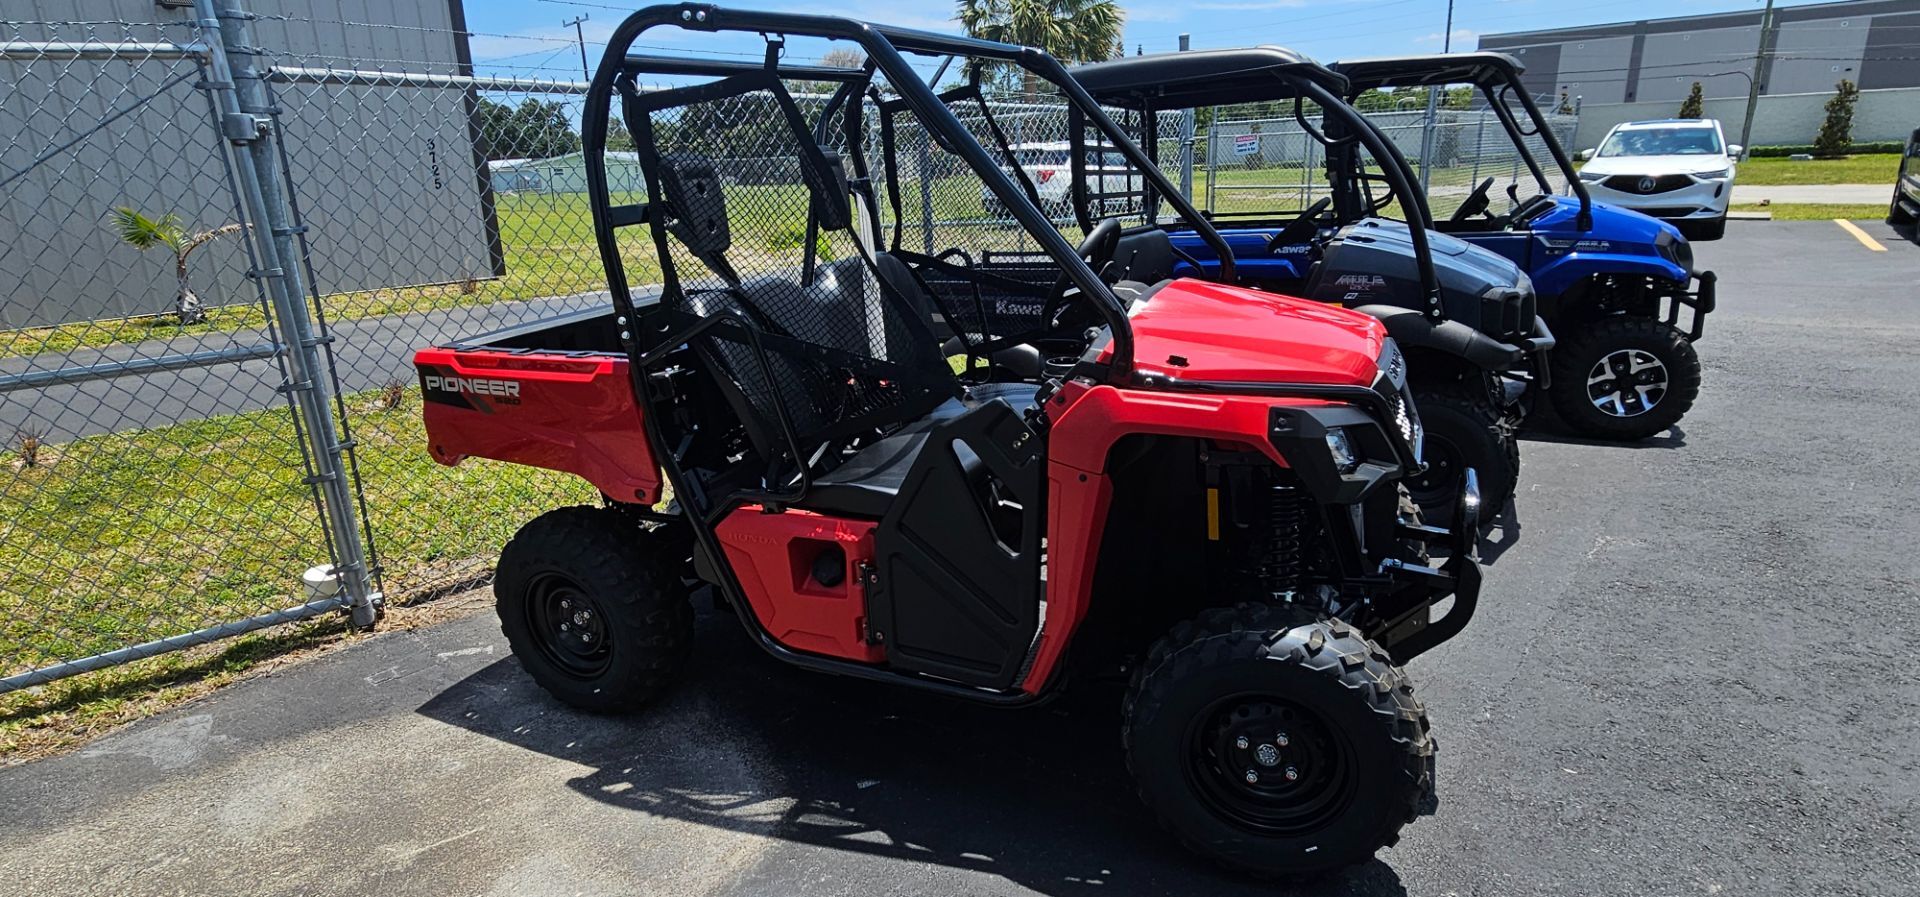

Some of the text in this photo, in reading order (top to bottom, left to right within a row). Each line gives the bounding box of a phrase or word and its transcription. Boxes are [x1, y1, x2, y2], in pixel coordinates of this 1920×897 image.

[426, 138, 442, 190] 3725
[995, 300, 1045, 315] Kawa
[425, 375, 520, 397] PIONEER
